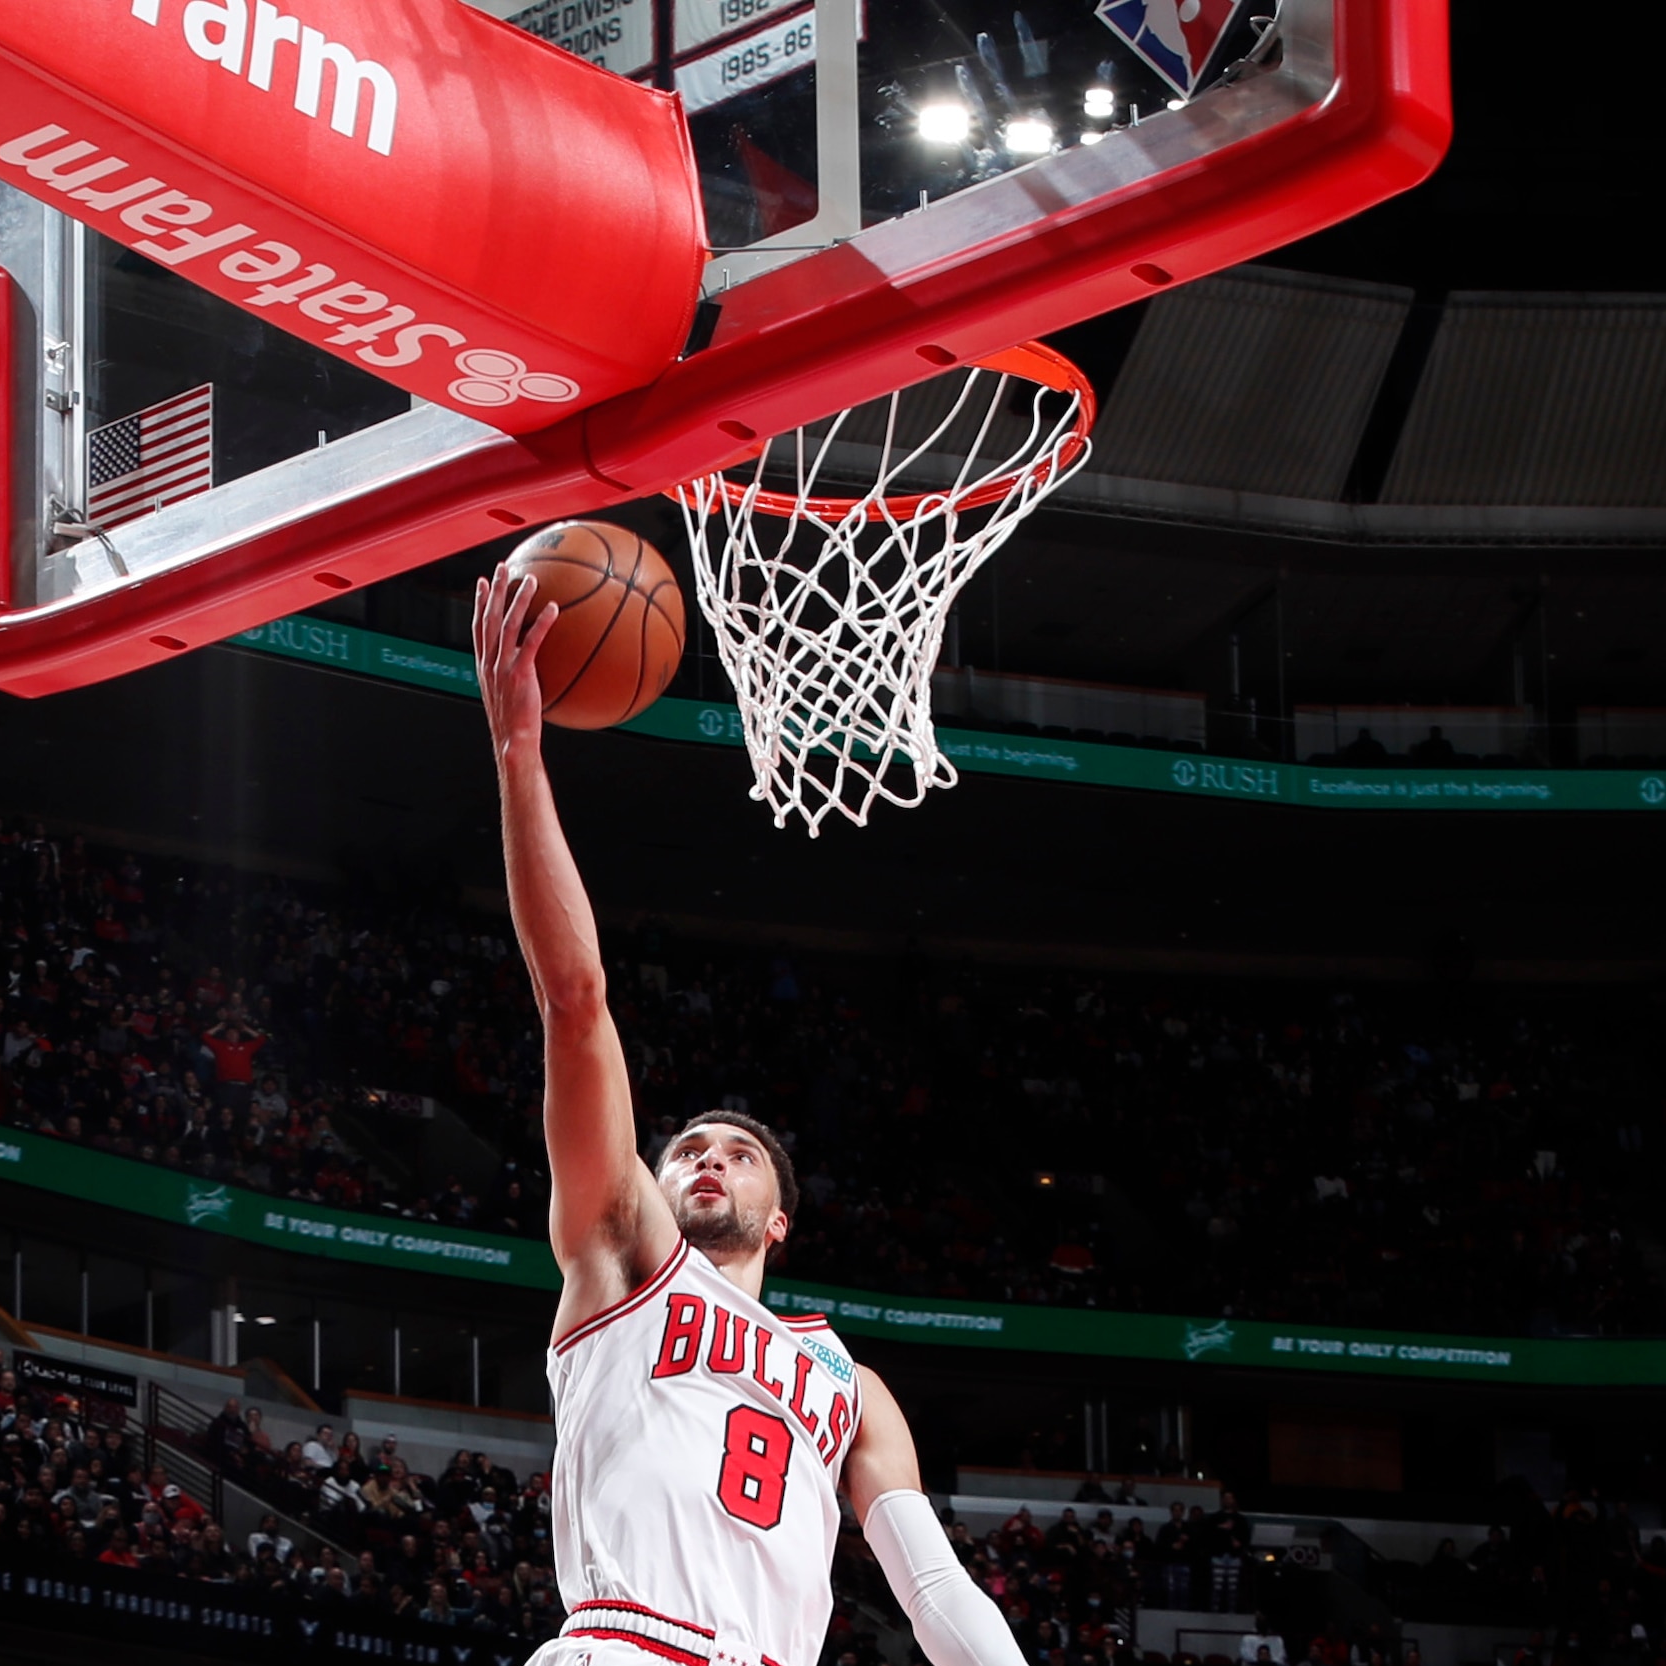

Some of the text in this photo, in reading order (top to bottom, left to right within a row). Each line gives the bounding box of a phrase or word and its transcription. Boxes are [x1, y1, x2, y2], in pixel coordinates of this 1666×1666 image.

[721, 22, 813, 85] 1985-86
[130, 0, 399, 157] arm
[266, 620, 349, 661] RUSH
[1199, 760, 1279, 795] RUSH
[1309, 778, 1552, 801] Excellence is just the beginning.
[263, 1211, 512, 1266] BE YOUR ONLY COMPETITION
[766, 1289, 1004, 1332] BE YOUR ONLY COMPETITION
[1271, 1335, 1512, 1366] BE YOUR ONLY COMPETITION
[650, 1292, 852, 1468] BULLS
[716, 1402, 794, 1531] 8
